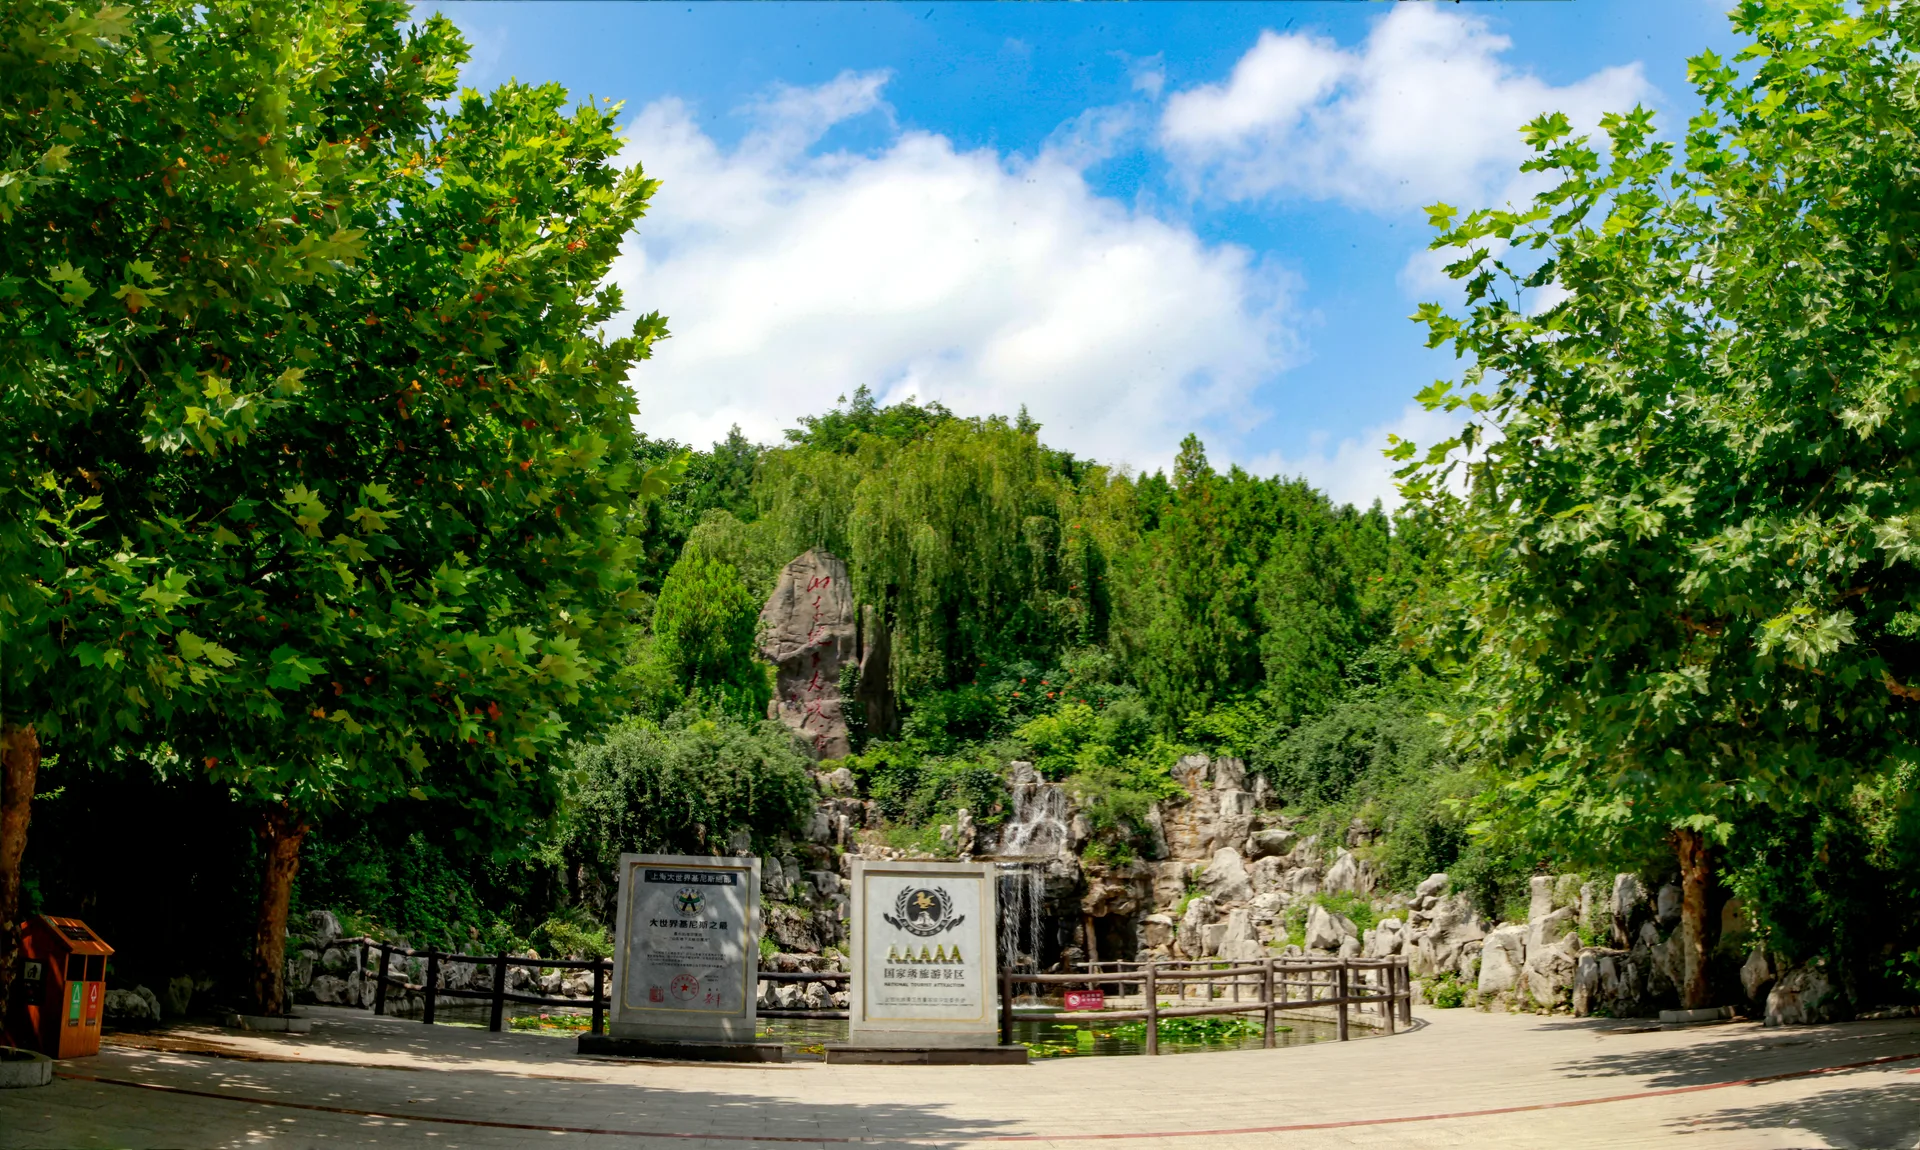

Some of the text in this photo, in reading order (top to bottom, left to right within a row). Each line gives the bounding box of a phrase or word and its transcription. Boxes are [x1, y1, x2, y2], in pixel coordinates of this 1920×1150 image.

[649, 918, 728, 930] 大世界基尼斯之最
[886, 942, 965, 965] AAAAA
[884, 968, 965, 980] 国家级旅游景区
